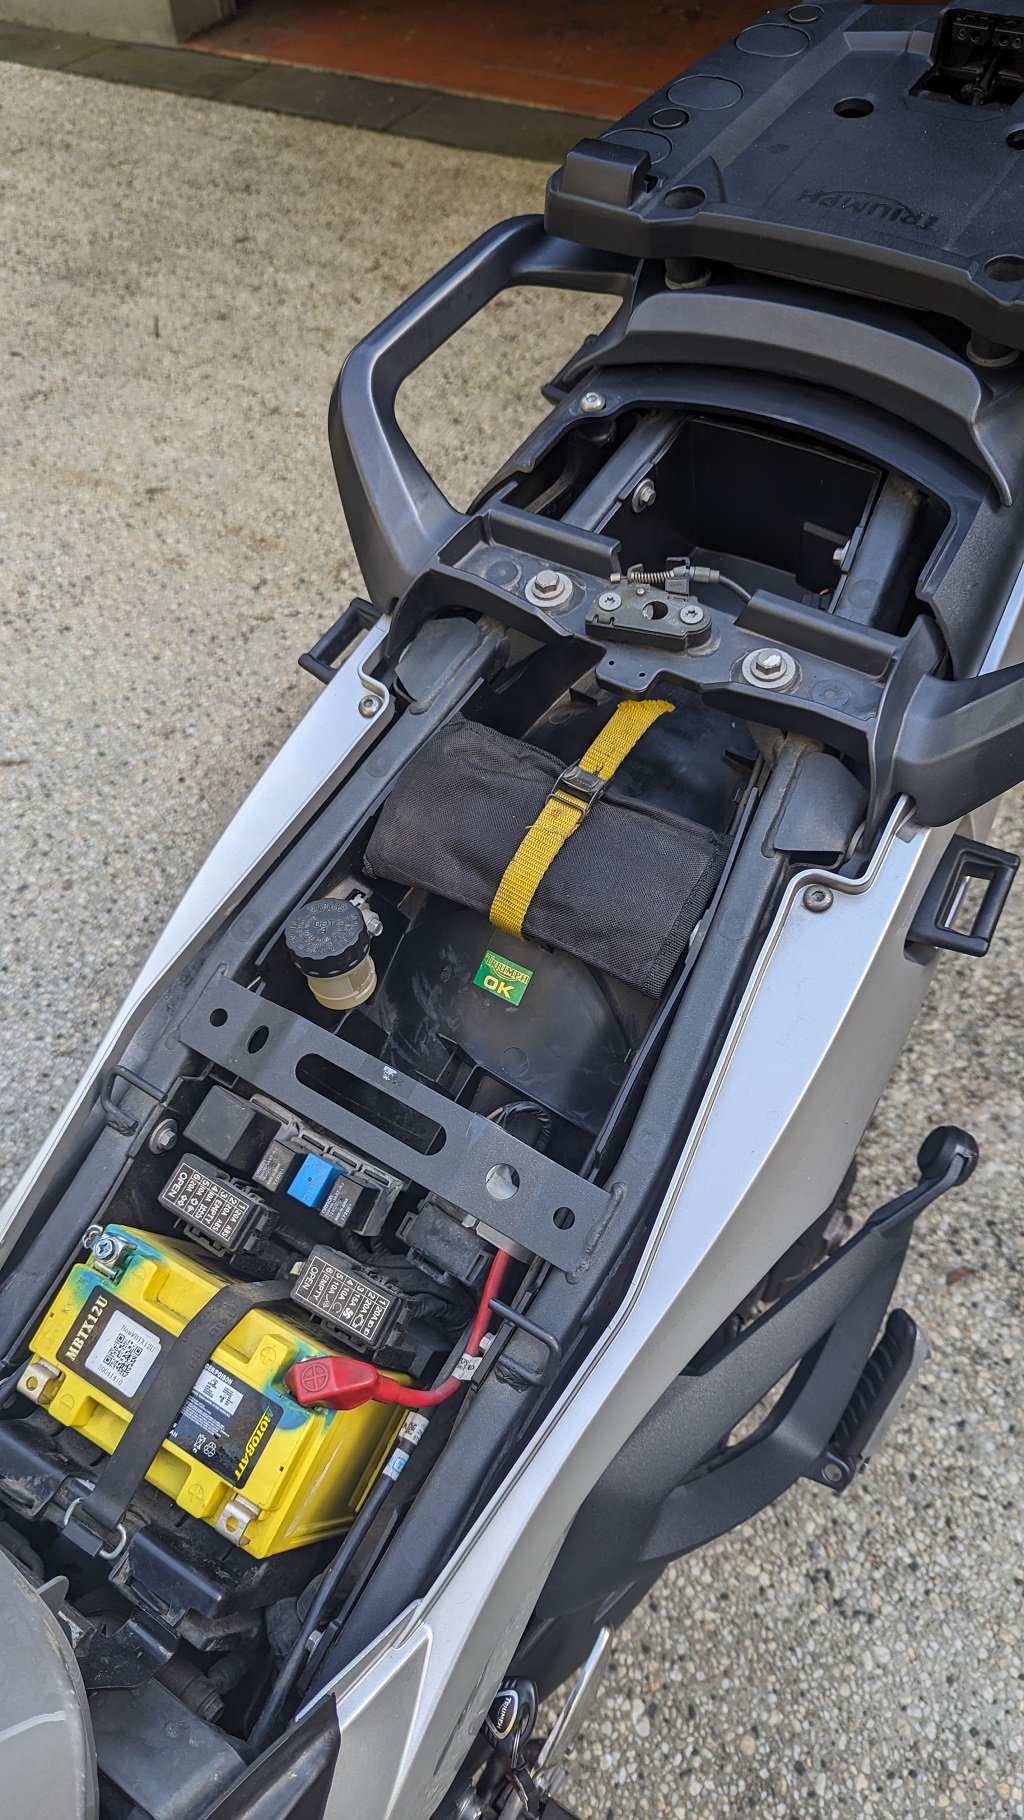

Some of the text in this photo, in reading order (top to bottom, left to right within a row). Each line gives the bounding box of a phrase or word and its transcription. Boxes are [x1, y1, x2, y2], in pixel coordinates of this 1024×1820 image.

[797, 190, 941, 232] TRIUMPH
[485, 953, 530, 984] TRIUMPH
[484, 975, 514, 999] OK
[168, 1172, 187, 1197] OPEN
[186, 1180, 196, 1192] 20A
[196, 1185, 205, 1196] 10A
[205, 1191, 214, 1202] 10A
[204, 1199, 222, 1224] EMPTY
[221, 1204, 232, 1216] 20A
[230, 1210, 241, 1222] 20A
[212, 1219, 222, 1231] ABS
[221, 1225, 232, 1238] ABS
[302, 1266, 319, 1290] OPEN
[313, 1274, 329, 1300] EMPTY
[328, 1282, 339, 1294] 10A
[338, 1287, 349, 1300] 10A
[349, 1294, 360, 1306] 15A
[360, 1300, 371, 1314] 20A
[371, 1306, 382, 1320] 20A
[65, 1295, 108, 1362] MBTX12U
[98, 1364, 123, 1386] 20041410
[169, 1430, 179, 1438] AH
[234, 1406, 274, 1481] MOTOBATT
[497, 1697, 512, 1729] TRIUMPH
